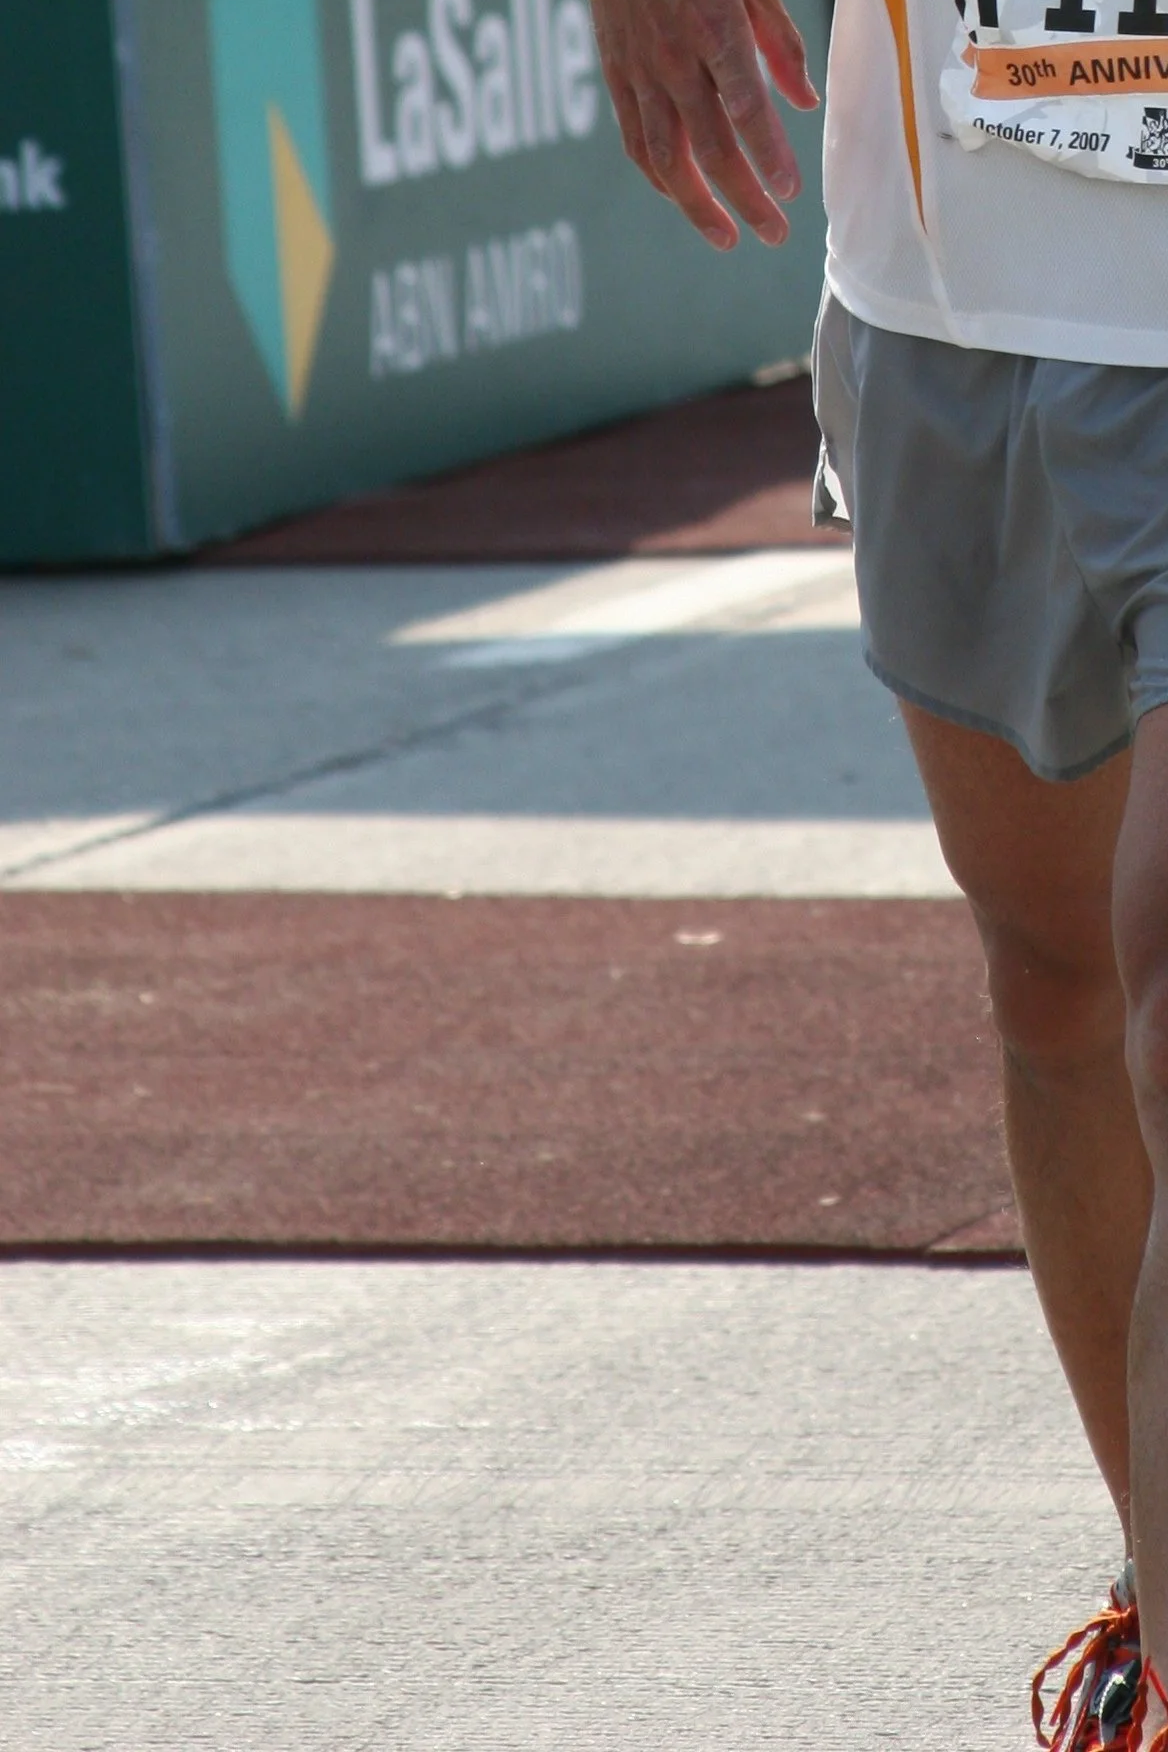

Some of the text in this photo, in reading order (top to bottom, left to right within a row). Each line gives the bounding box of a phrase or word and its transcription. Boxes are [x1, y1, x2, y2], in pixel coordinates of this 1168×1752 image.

[1006, 58, 1057, 88] 30th
[973, 117, 1112, 153] October 7, 2007
[369, 219, 584, 379] ABN AMRO
